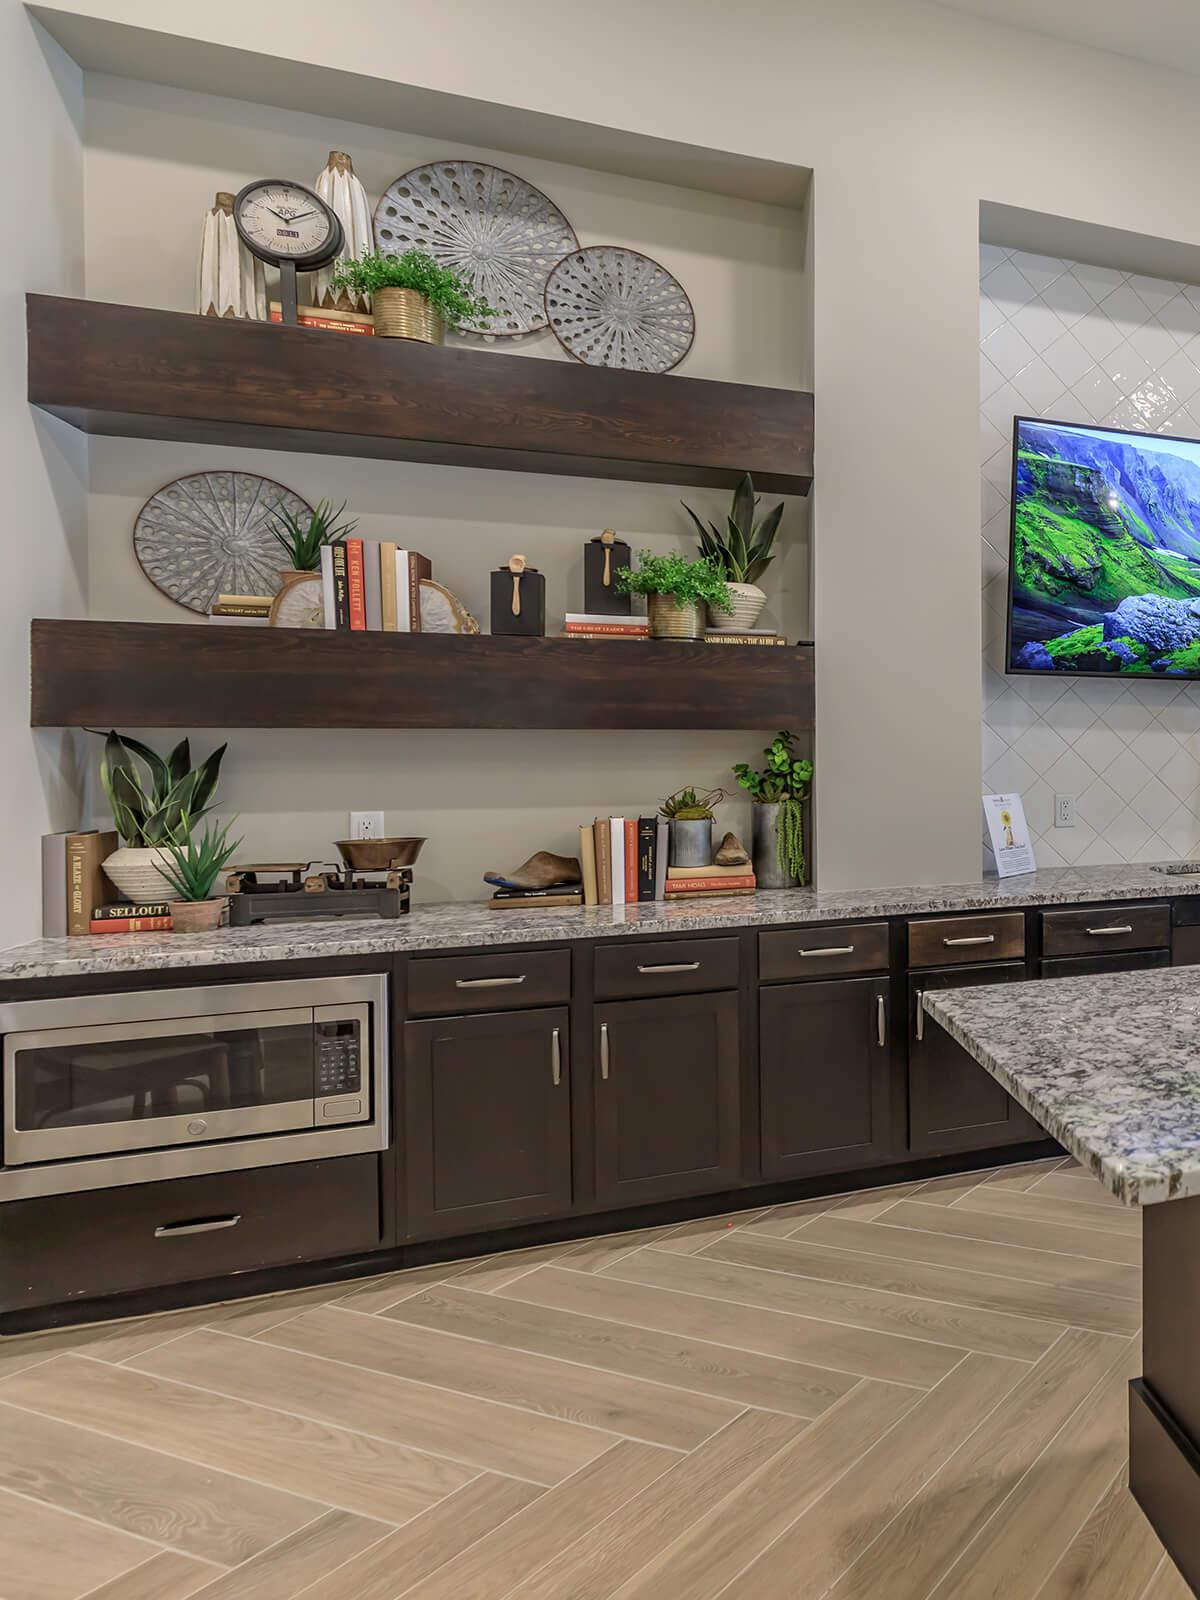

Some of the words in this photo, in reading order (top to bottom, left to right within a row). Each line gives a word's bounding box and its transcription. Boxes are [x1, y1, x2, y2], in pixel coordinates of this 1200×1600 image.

[351, 560, 361, 576] KEN
[351, 578, 361, 611] FOLLETT
[109, 905, 165, 918] SELLOUT
